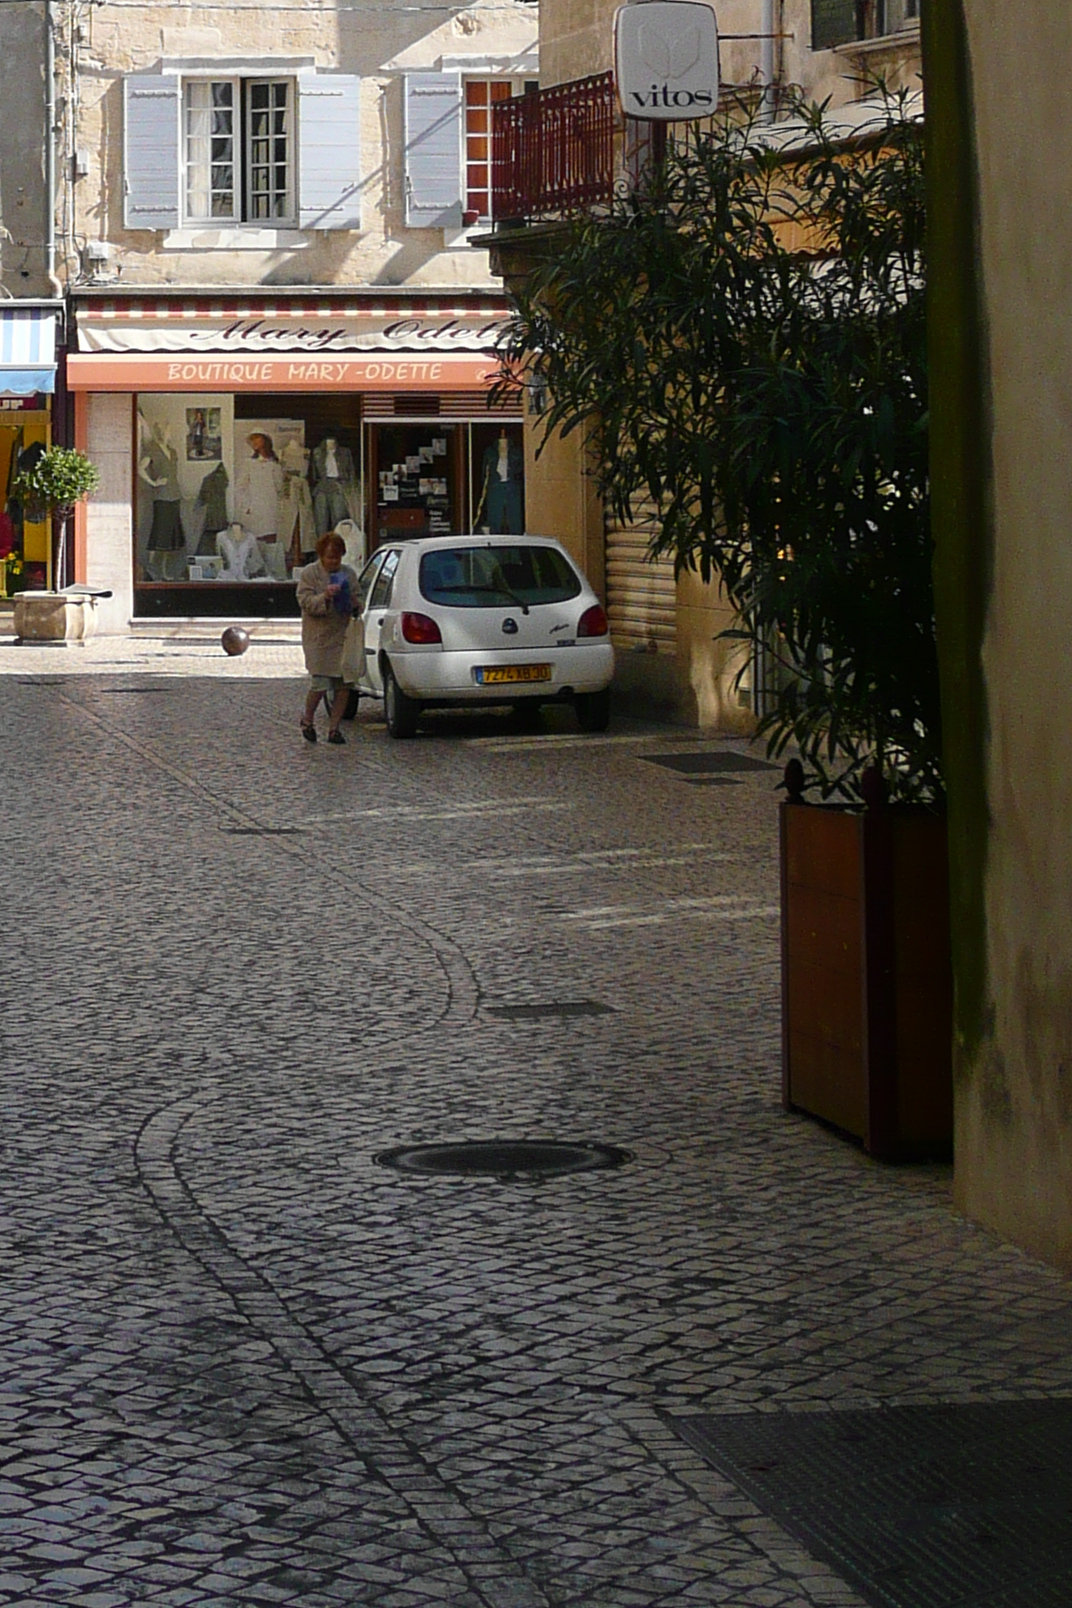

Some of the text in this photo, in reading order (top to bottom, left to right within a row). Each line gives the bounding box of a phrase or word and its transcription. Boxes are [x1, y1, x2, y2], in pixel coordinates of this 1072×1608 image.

[629, 82, 713, 108] vitos
[189, 318, 350, 347] Mary
[167, 362, 273, 382] BOUTIQUE
[288, 362, 350, 382] MARY
[483, 667, 514, 682] 7274
